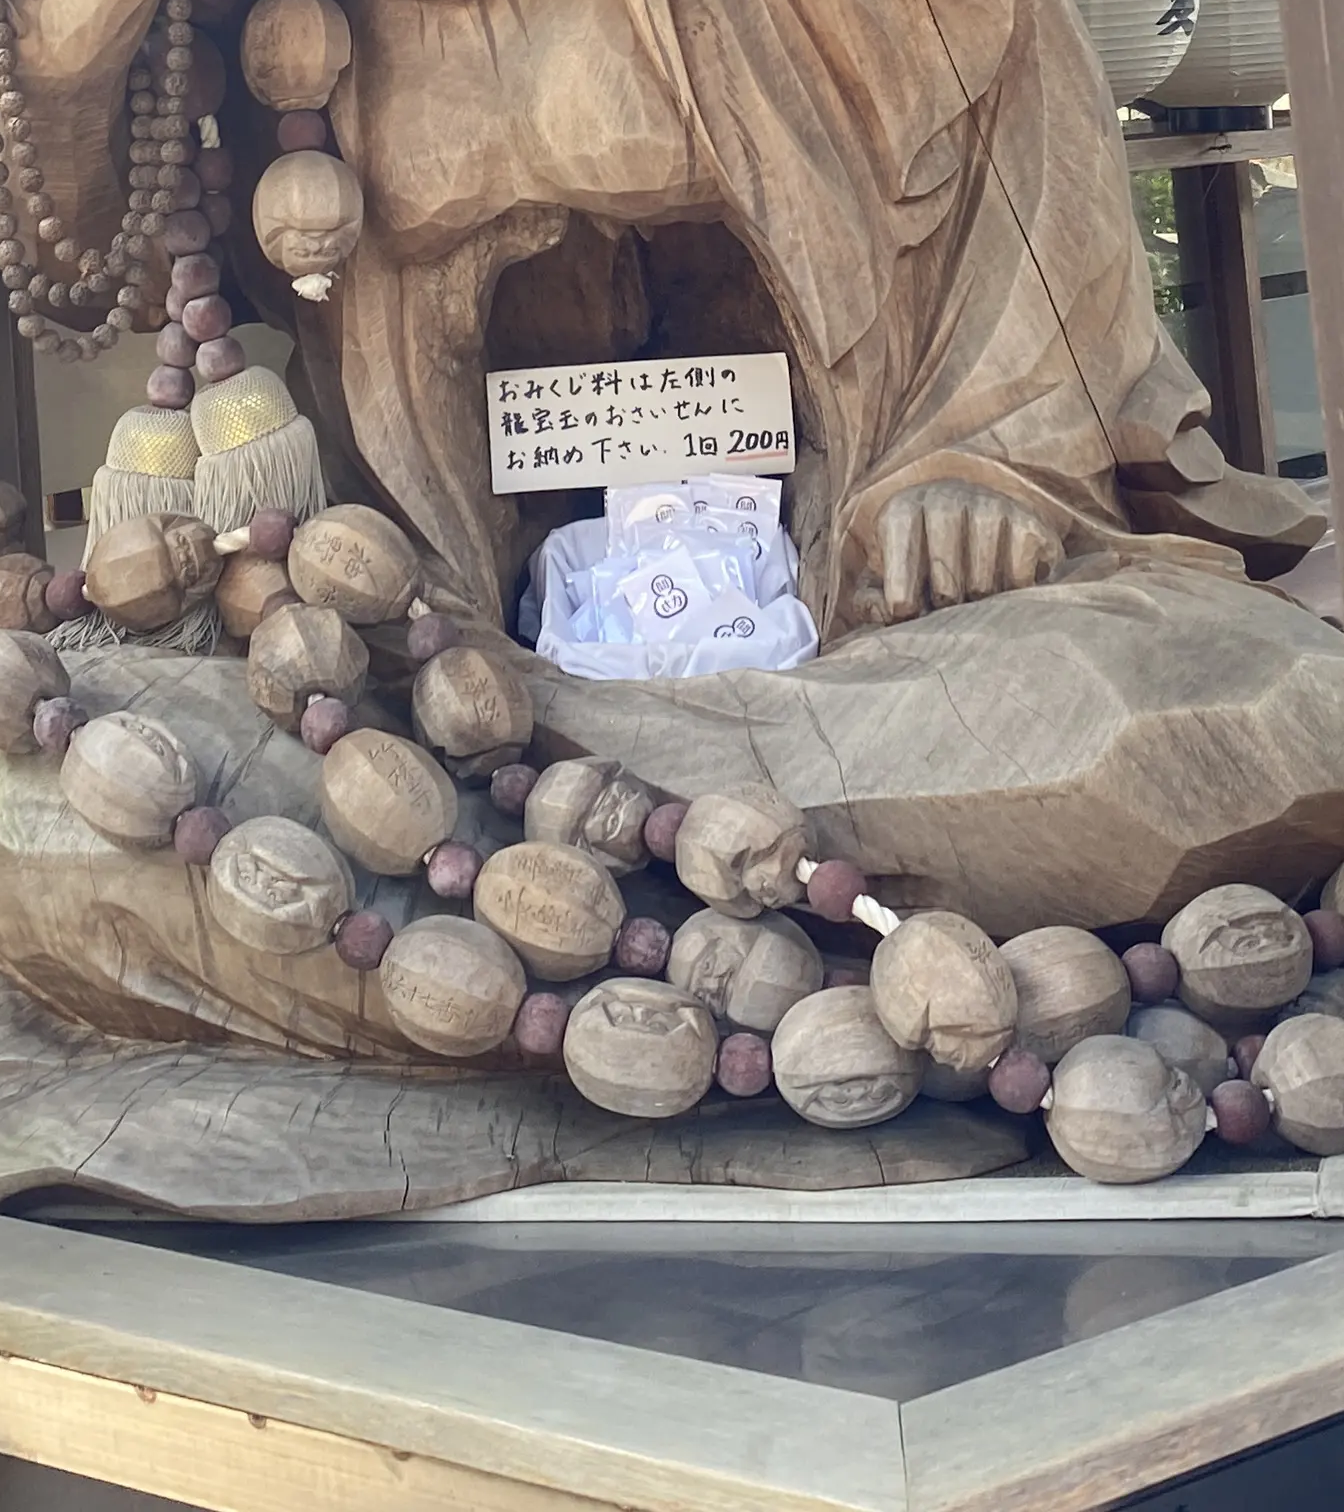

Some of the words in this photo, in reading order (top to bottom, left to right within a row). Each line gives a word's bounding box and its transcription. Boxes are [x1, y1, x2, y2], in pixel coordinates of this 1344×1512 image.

[498, 366, 738, 403] おみくじ料は左側の
[500, 397, 745, 436] 龍宝玉のおさいせんに
